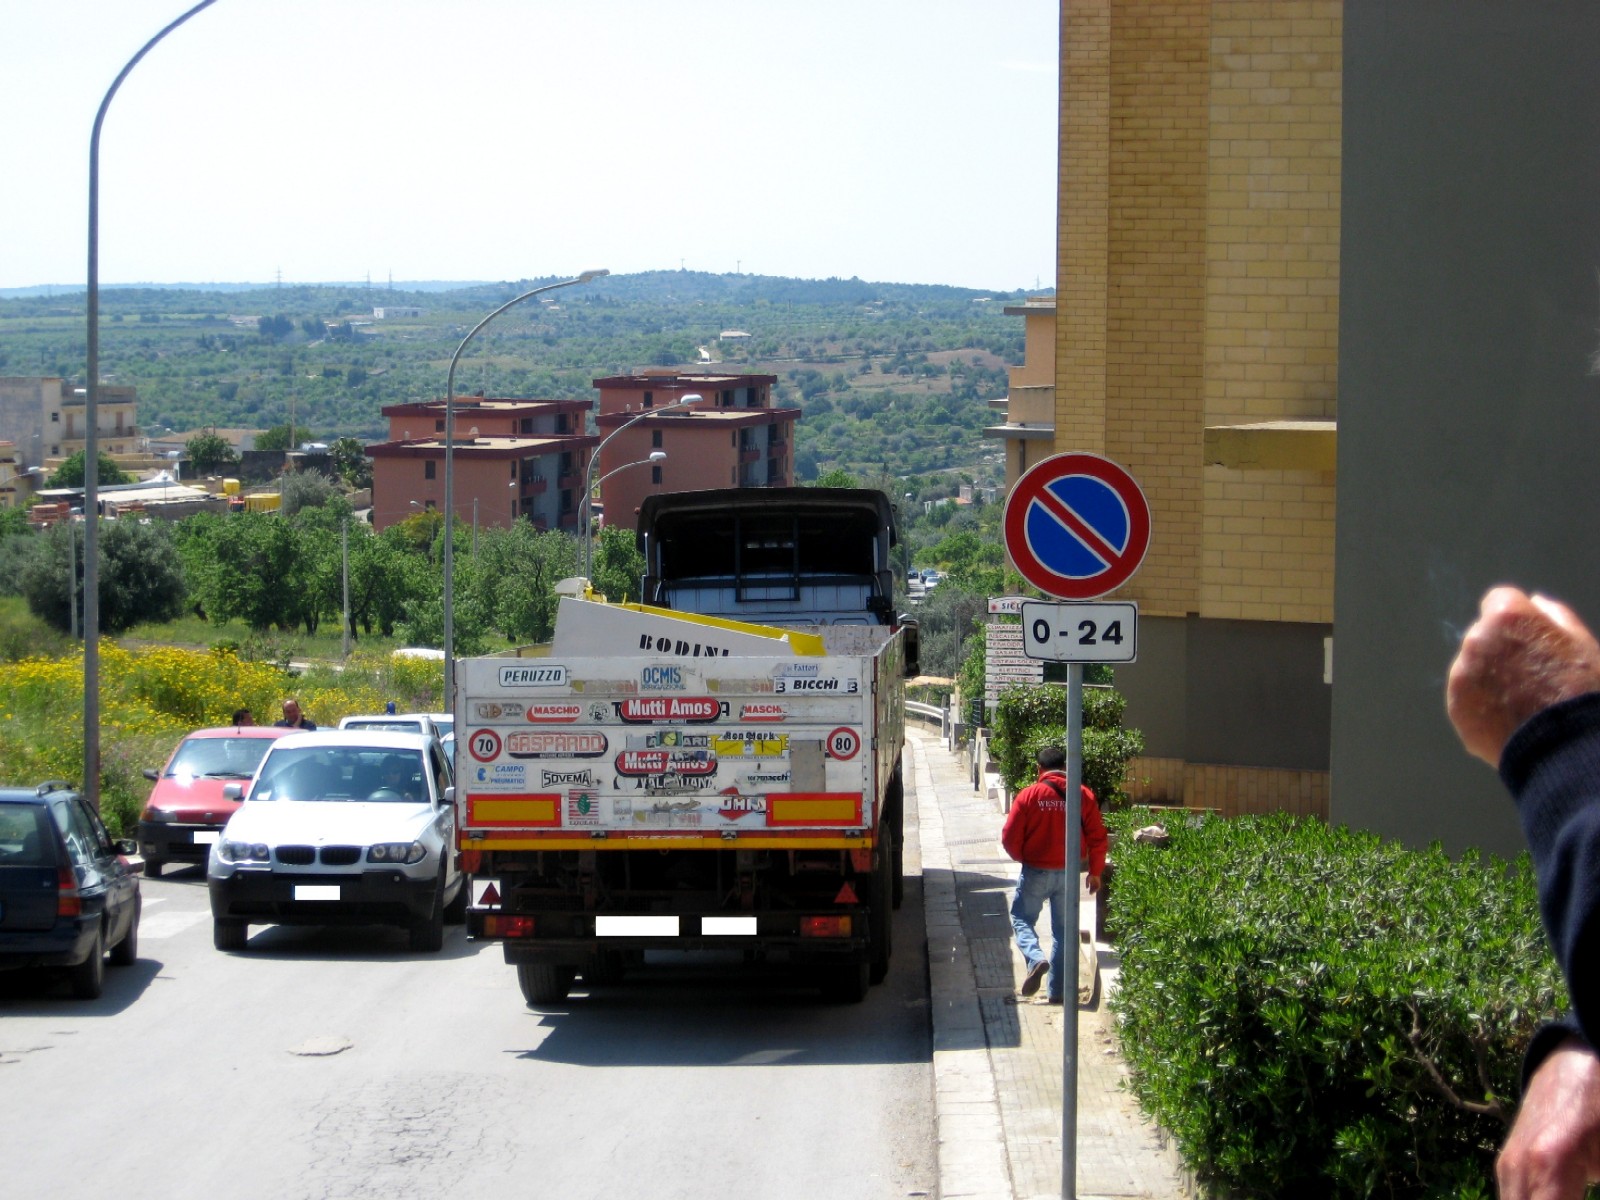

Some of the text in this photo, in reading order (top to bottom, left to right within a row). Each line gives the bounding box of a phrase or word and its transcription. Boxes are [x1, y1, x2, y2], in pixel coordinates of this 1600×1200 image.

[504, 670, 562, 682] PERUZZO
[642, 666, 682, 685] OCMIS
[534, 705, 580, 715] MASCHIO
[628, 699, 666, 716] Mutti
[669, 699, 712, 716] Amos
[478, 738, 494, 753] 70
[507, 735, 603, 752] GASPARDO
[835, 737, 852, 751] 80
[624, 751, 662, 770] Mutti
[495, 765, 525, 773] CAMPO
[490, 777, 525, 785] PNEUMATICI
[543, 773, 591, 786] SOVEMA
